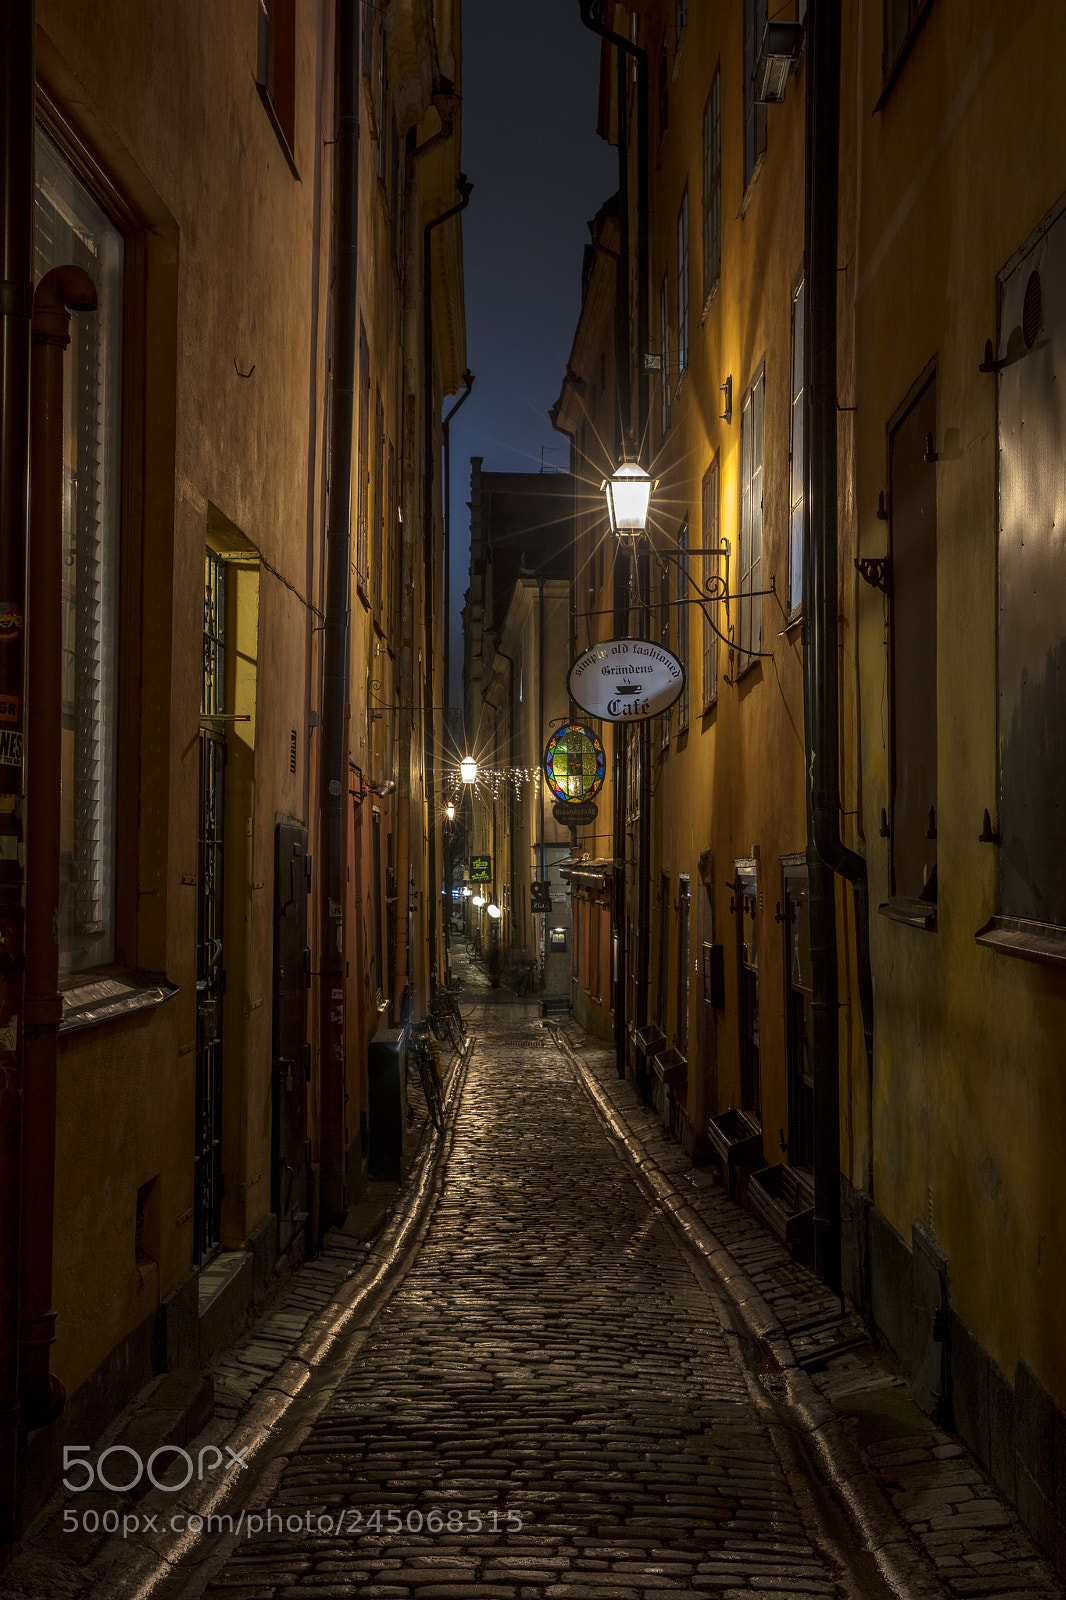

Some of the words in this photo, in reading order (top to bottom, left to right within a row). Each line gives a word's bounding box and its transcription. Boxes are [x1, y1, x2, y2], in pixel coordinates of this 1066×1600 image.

[575, 649, 608, 676] simply
[611, 643, 628, 655] old
[633, 643, 681, 678] fashioned
[601, 664, 654, 676] Grändens
[607, 698, 650, 717] Café
